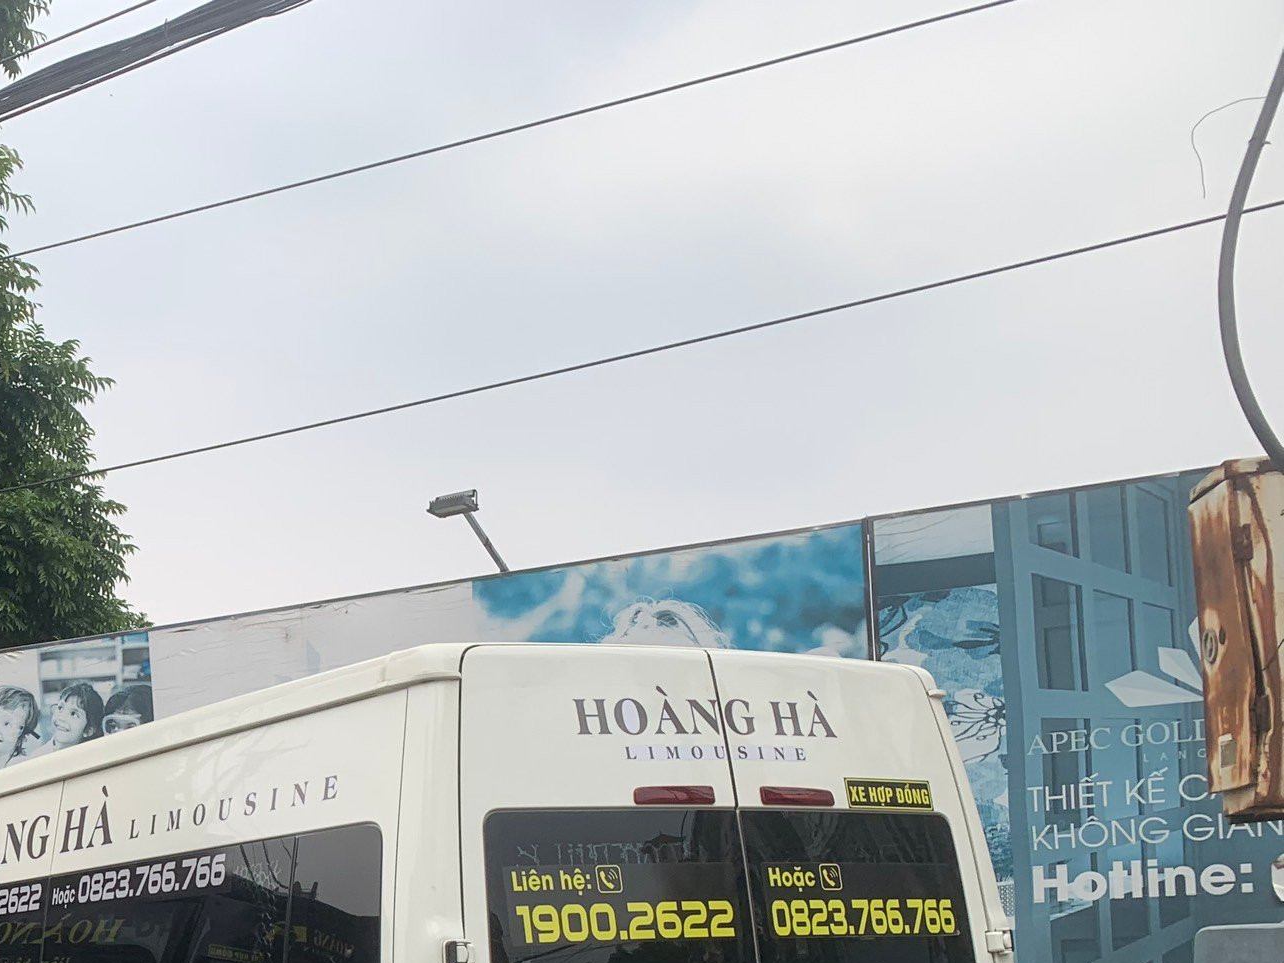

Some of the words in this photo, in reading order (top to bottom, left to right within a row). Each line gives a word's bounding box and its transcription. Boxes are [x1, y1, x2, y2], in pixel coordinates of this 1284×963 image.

[573, 686, 755, 736] HOÀNG
[769, 691, 837, 738] HÀ
[625, 746, 807, 761] LIMOUSINE
[1027, 727, 1111, 756] APEC
[849, 786, 867, 802] XE
[868, 786, 893, 806] HỢP
[1027, 772, 1113, 812] THIẾT
[1126, 766, 1168, 805] KẾ
[1179, 774, 1217, 800] C
[59, 785, 112, 854] HÀ
[129, 775, 338, 840] LIMOUSINE
[1032, 816, 1170, 850] KHÔNG
[52, 885, 75, 909] Hoặc
[78, 853, 226, 904] 0823.766.766
[511, 867, 555, 892] Liên
[560, 866, 592, 895] hệ:
[768, 866, 816, 892] Hoặc
[1032, 859, 1253, 903] Hotline:
[515, 900, 736, 943] 1900.2622
[771, 899, 956, 936] 0823.766.766
